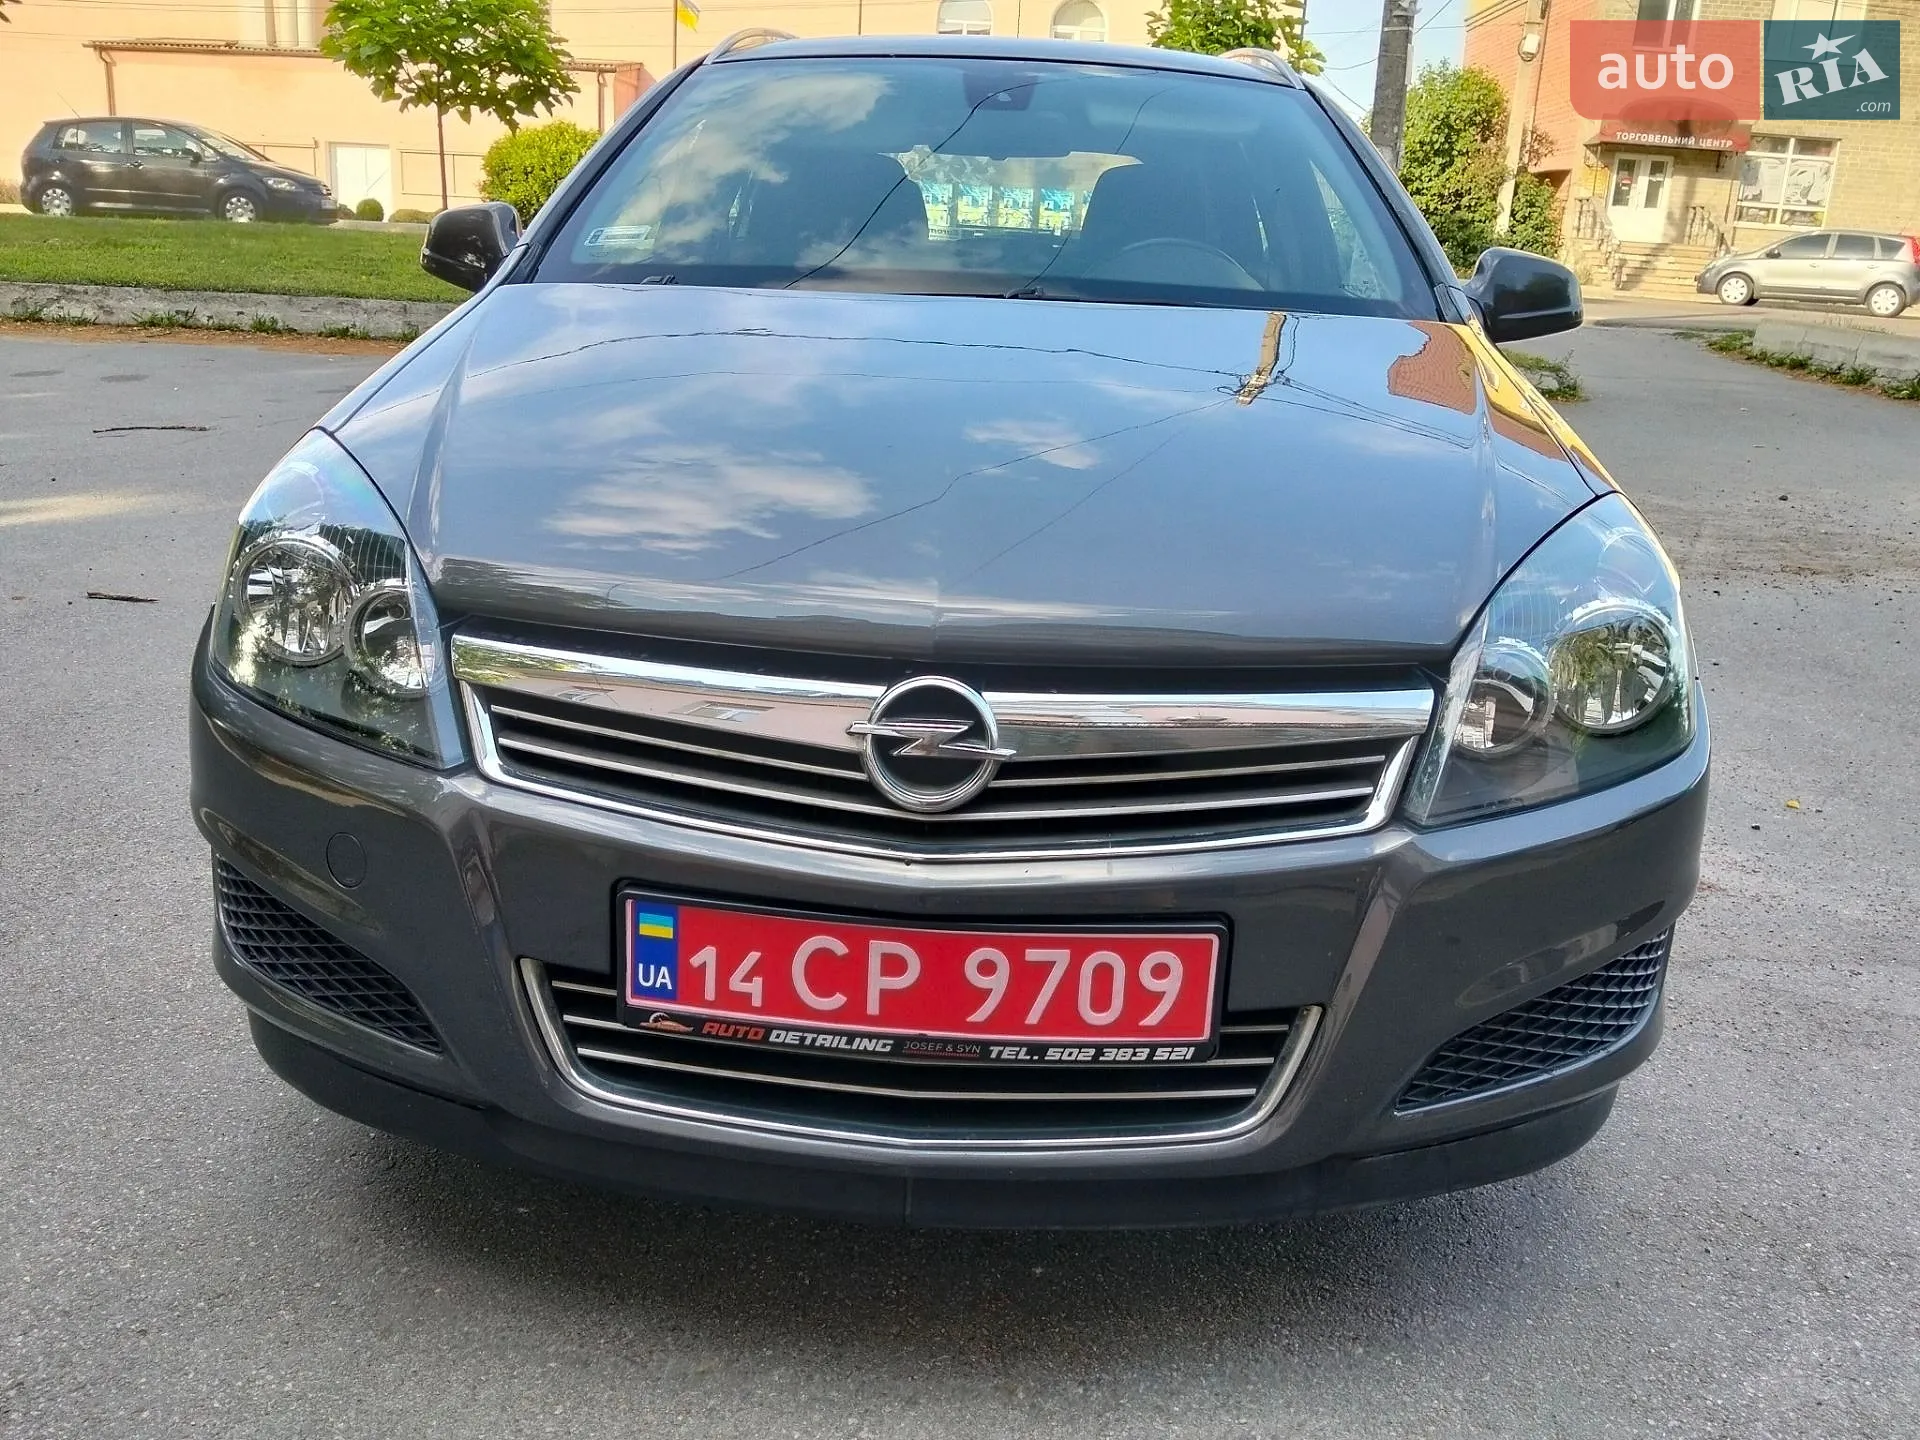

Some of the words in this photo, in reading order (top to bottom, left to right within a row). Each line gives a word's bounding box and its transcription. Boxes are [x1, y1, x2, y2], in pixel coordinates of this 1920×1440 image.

[1616, 132, 1695, 146] ТОРГОВЕЛЬНИЙ
[1699, 138, 1733, 148] ЦЕНТР
[638, 963, 673, 990] UA
[689, 945, 764, 1008] 14
[792, 935, 921, 1016] CP
[964, 949, 1184, 1027] 9709
[703, 1021, 766, 1041] AUTO
[769, 1029, 894, 1052] DETAILING
[903, 1041, 944, 1052] JOSEF
[945, 1043, 954, 1053] &
[956, 1043, 981, 1055] SYN
[988, 1045, 1039, 1060] TEL.
[1044, 1047, 1098, 1061] 502
[1099, 1047, 1150, 1061] 383
[1153, 1046, 1195, 1061] 521
